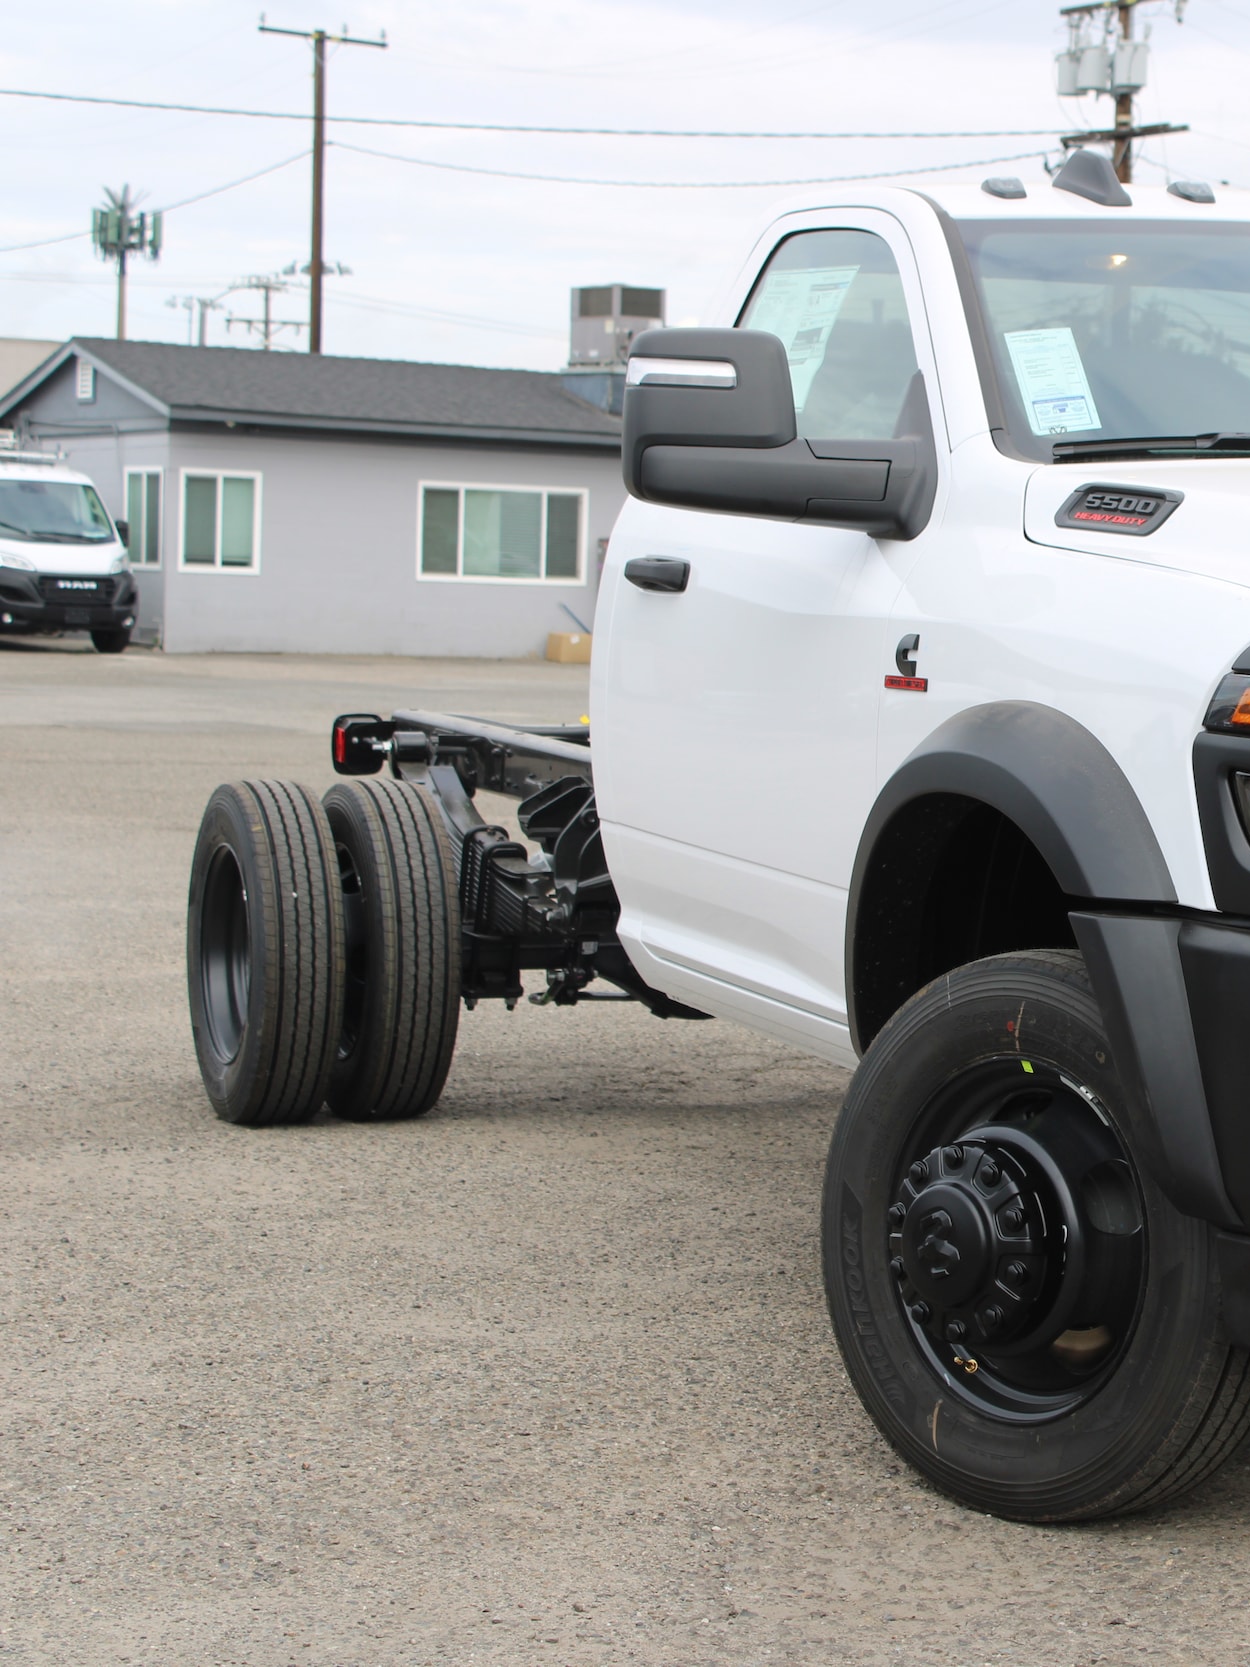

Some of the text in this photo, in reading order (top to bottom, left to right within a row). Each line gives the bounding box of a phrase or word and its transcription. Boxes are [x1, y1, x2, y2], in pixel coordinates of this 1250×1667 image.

[1085, 494, 1156, 514] 5500
[1074, 511, 1147, 525] HEAVY DUTY
